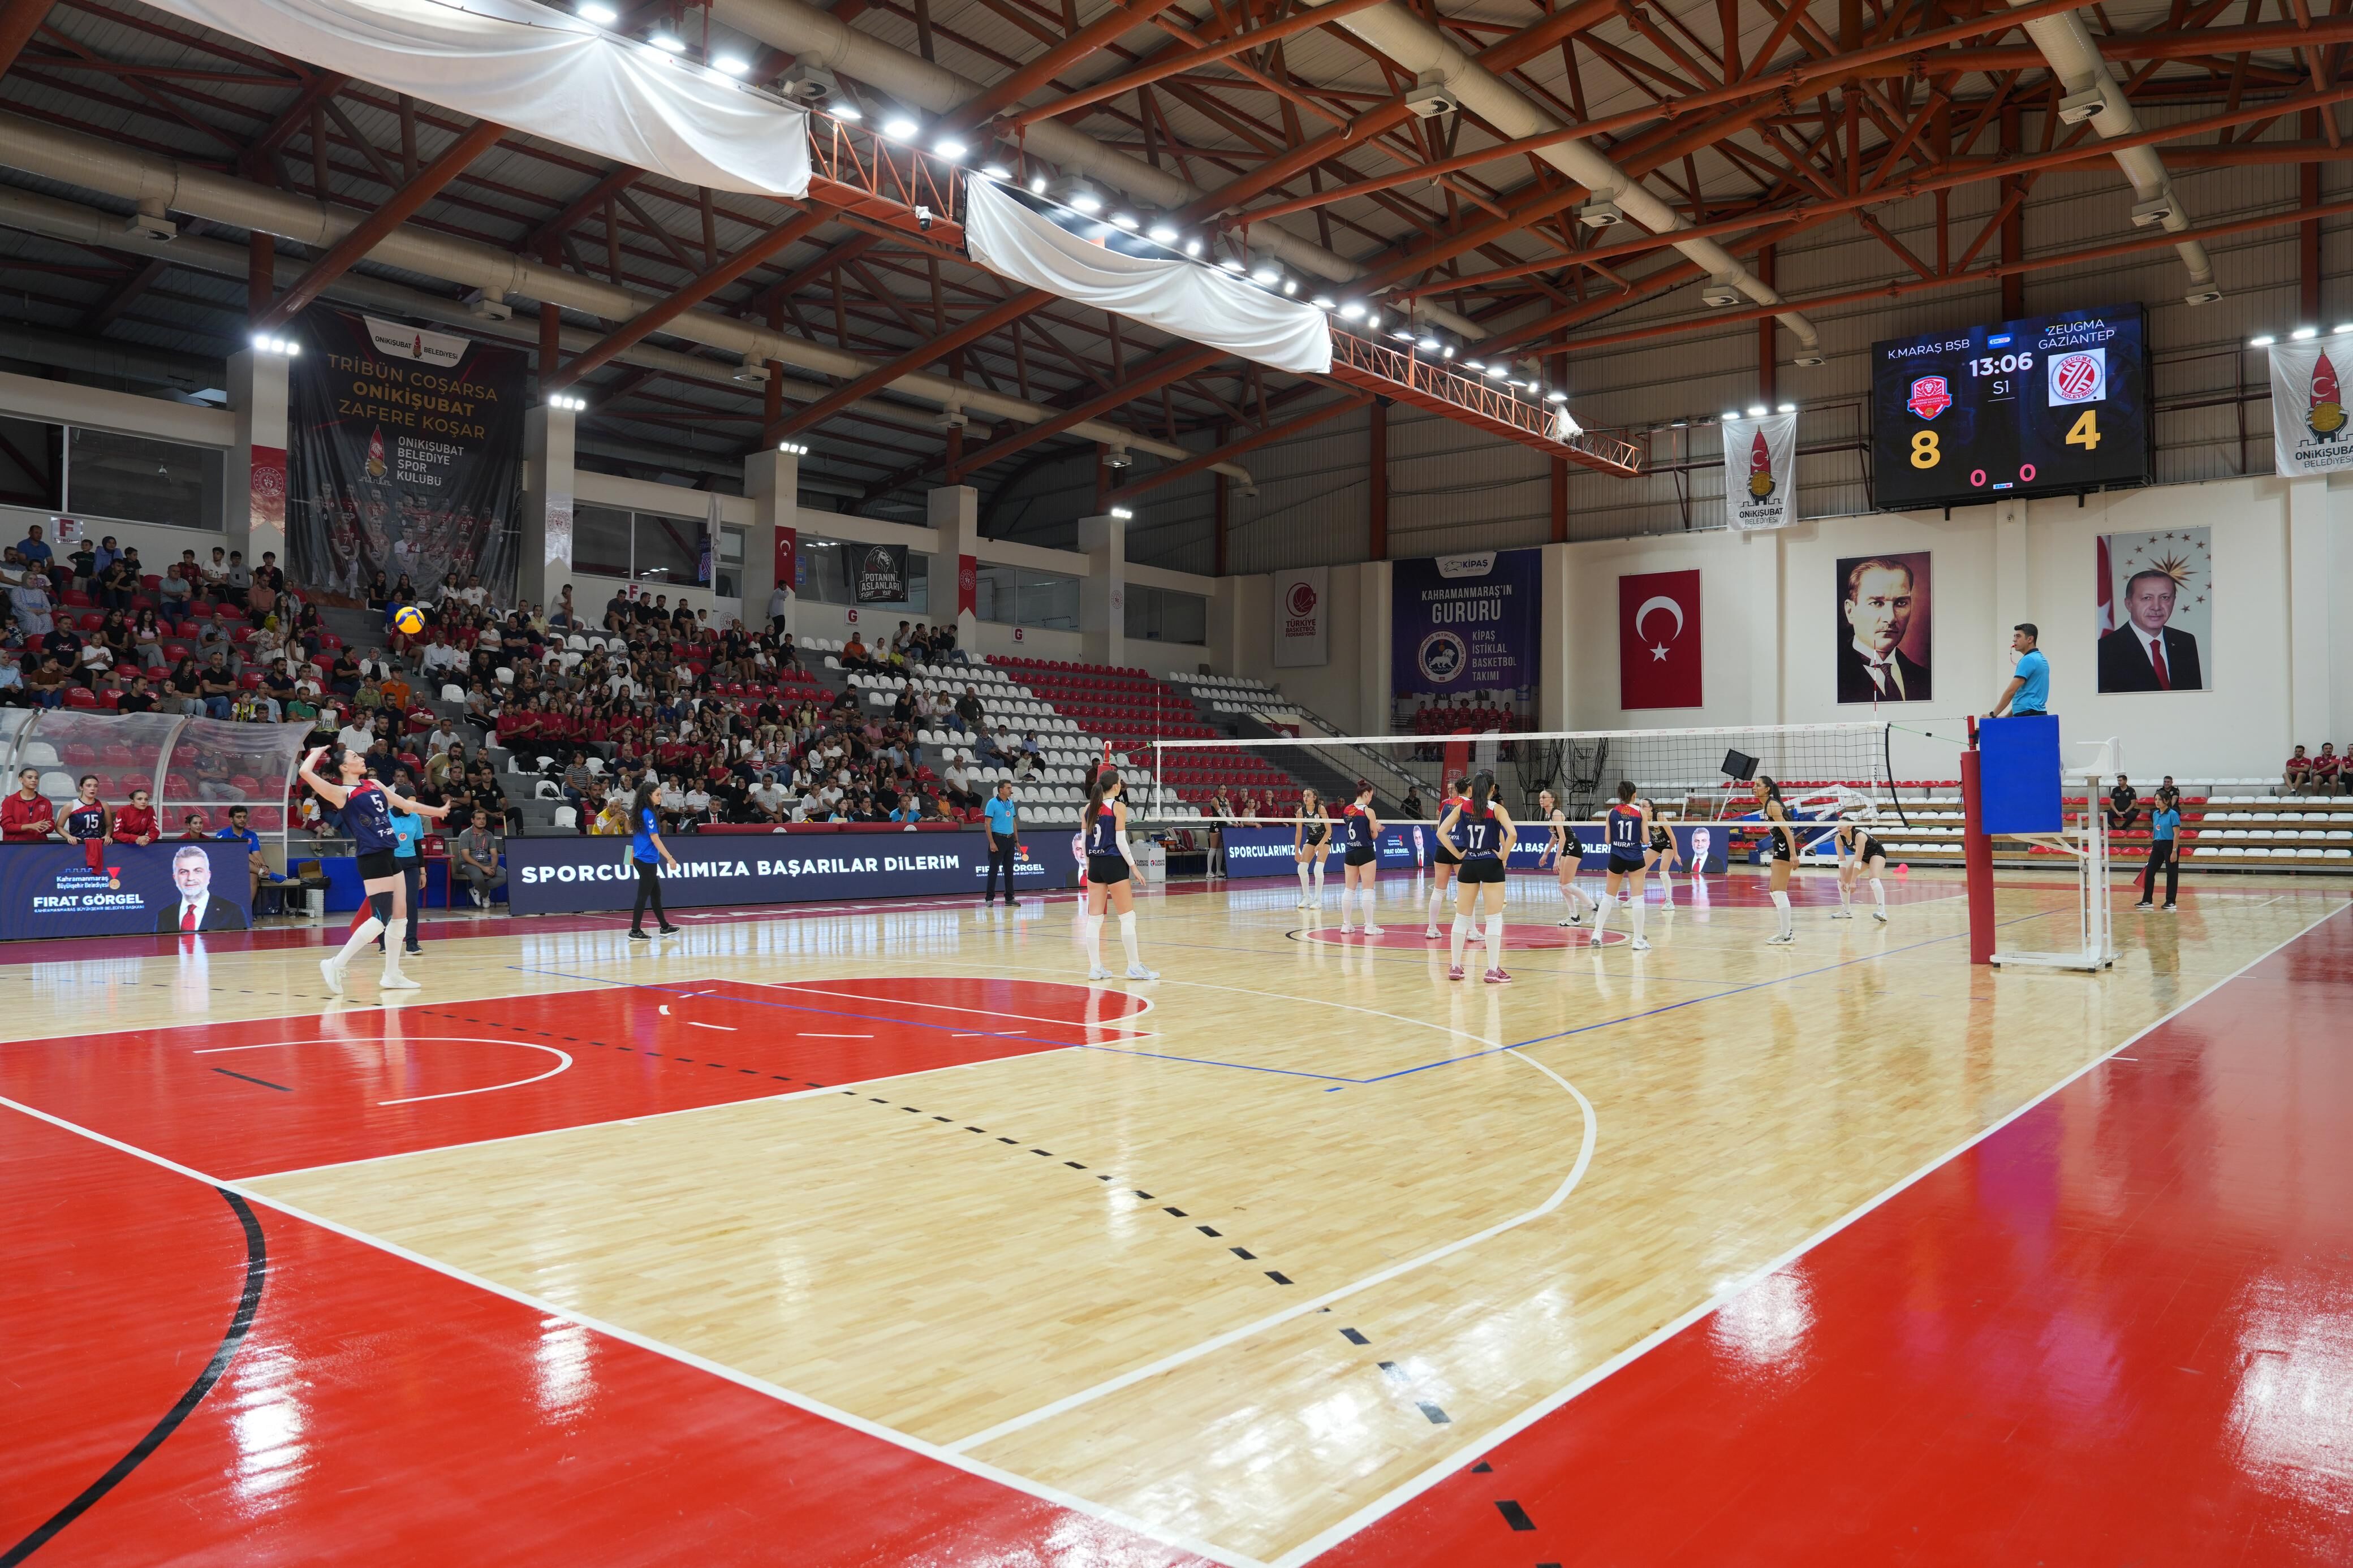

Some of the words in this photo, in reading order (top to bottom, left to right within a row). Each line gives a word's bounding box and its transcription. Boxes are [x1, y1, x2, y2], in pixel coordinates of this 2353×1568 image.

[2048, 319, 2105, 336] ZEUGMA
[2039, 330, 2115, 349] GAZİANTEP
[1888, 343, 1942, 359] K.MARAŞ
[1946, 339, 1970, 351] BŞB
[1969, 352, 2033, 377] 13:06
[2061, 356, 2092, 368] ZEUGMA
[327, 353, 403, 383] TRİBÜN
[410, 372, 498, 401] COŞARSA
[1993, 380, 2009, 395] S1
[2061, 388, 2094, 399] VOLEYBOL
[339, 399, 415, 426] ZAFERE
[423, 416, 485, 439] KOŞAR
[2065, 409, 2101, 451] 4
[1910, 430, 1941, 469] 8
[398, 459, 427, 473] SPOR
[397, 470, 442, 486] KULÜBÜ
[1971, 469, 1986, 487] 0
[2019, 464, 2036, 482] 0
[59, 519, 74, 537] F
[1463, 559, 1488, 568] KİPAŞ
[865, 573, 895, 582] POTANIN
[630, 585, 638, 598] F
[861, 582, 899, 591] ASLANLARI
[848, 610, 857, 623] G
[1432, 599, 1501, 624] GURURU
[1286, 617, 1316, 627] TÜRKİYE
[1015, 628, 1023, 640] G
[1472, 629, 1496, 642] KİPAŞ
[1472, 643, 1507, 654] İSTİKLAL
[1472, 656, 1516, 668] BASKETBOL
[1472, 671, 1499, 681] TAKIMI
[370, 794, 385, 813] 5
[84, 814, 99, 829] 15
[1093, 823, 1102, 847] 9
[1348, 822, 1356, 840] 6
[1467, 824, 1485, 849] 17
[1618, 820, 1633, 841] 11
[1229, 843, 1302, 858] SPORCULARIMIZ
[757, 858, 878, 877] BAŞARILAR
[33, 896, 79, 907] FIRAT
[83, 893, 144, 905] GÖRGEL
